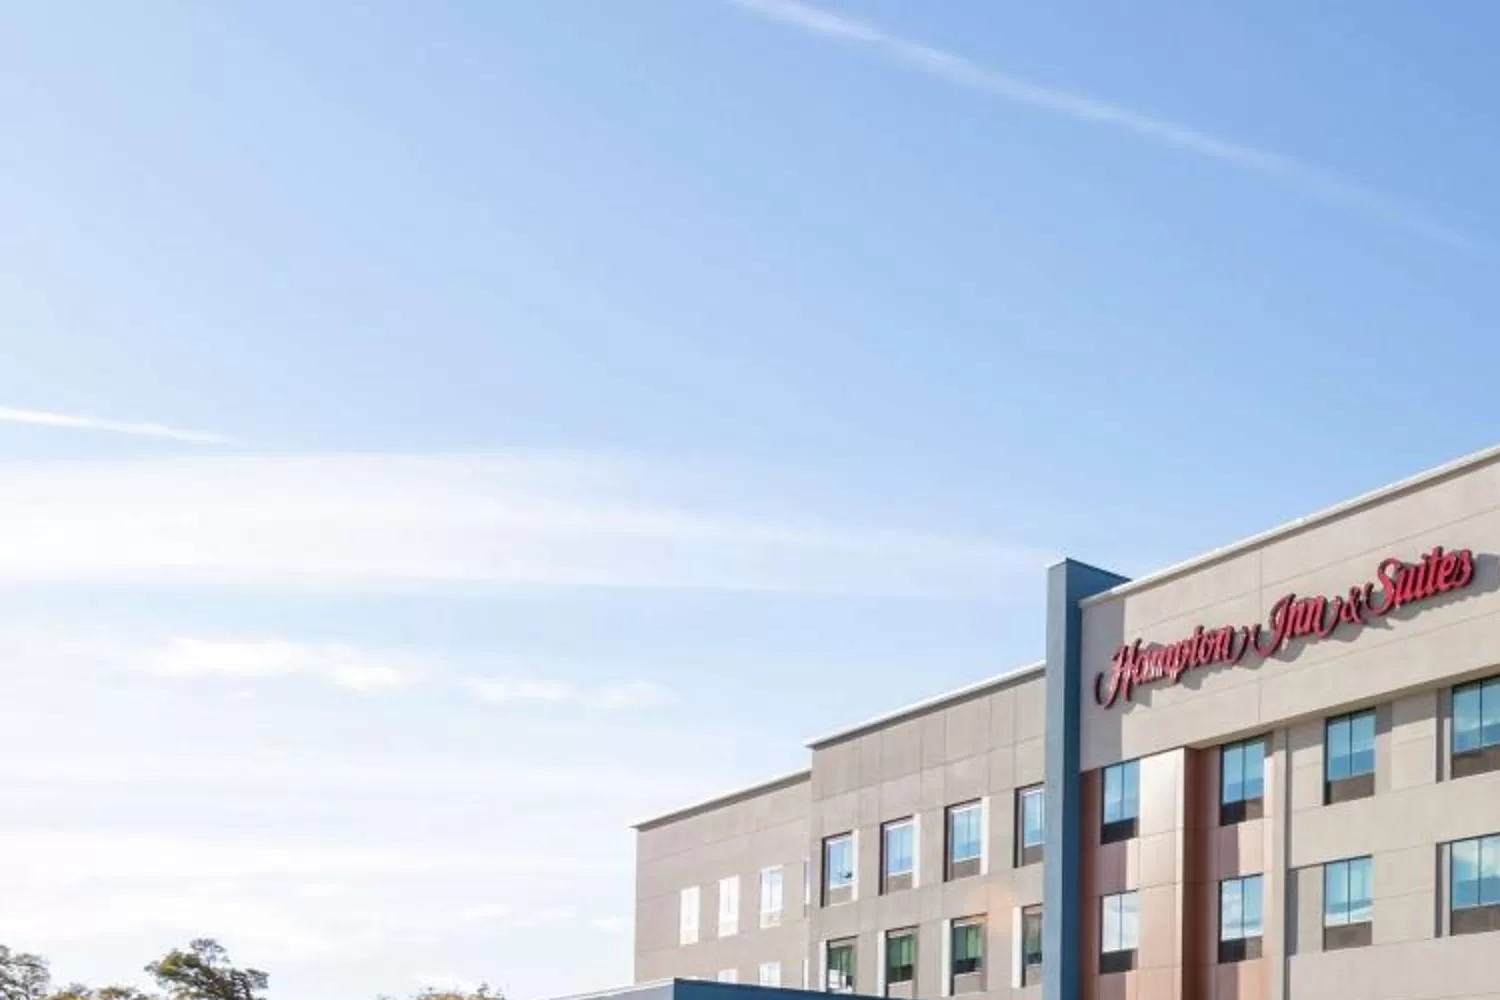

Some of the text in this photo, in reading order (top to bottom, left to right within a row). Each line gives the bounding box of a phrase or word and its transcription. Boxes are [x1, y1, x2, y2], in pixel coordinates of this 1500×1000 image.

[1095, 545, 1474, 710] Hampton Inn & Suites
